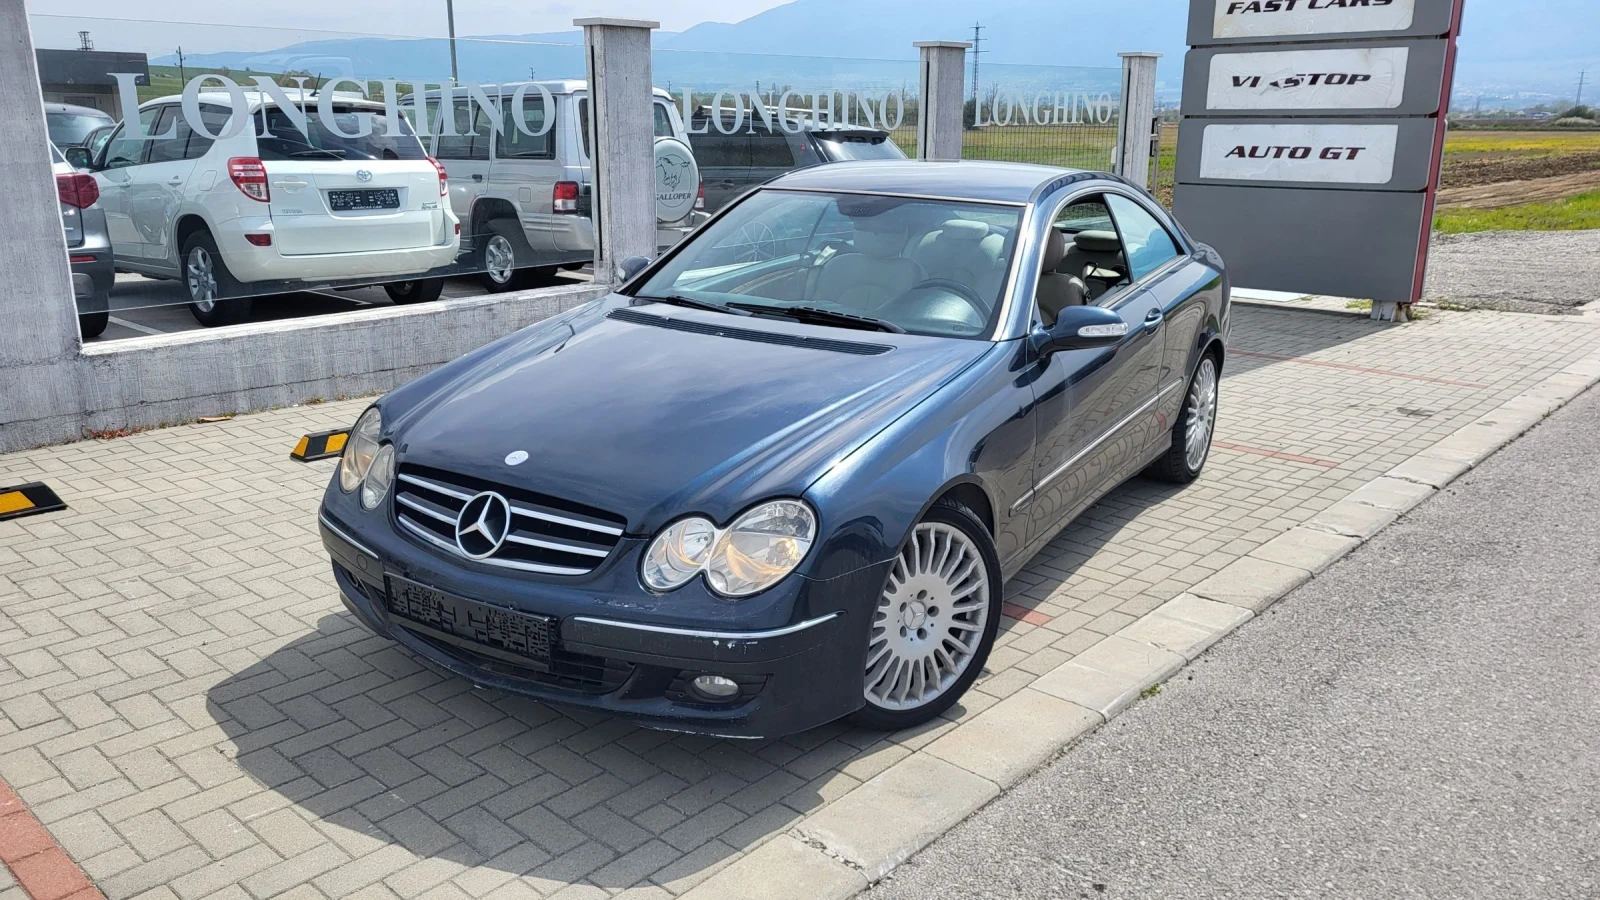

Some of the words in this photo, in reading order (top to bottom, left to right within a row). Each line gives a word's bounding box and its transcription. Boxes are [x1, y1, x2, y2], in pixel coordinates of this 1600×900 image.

[1226, 0, 1299, 14] FAST
[107, 72, 556, 140] LONGHINO
[681, 87, 905, 135] LONGHINO
[972, 90, 1113, 127] LONGHINO
[1224, 145, 1312, 160] AUTO
[1318, 146, 1367, 160] GT
